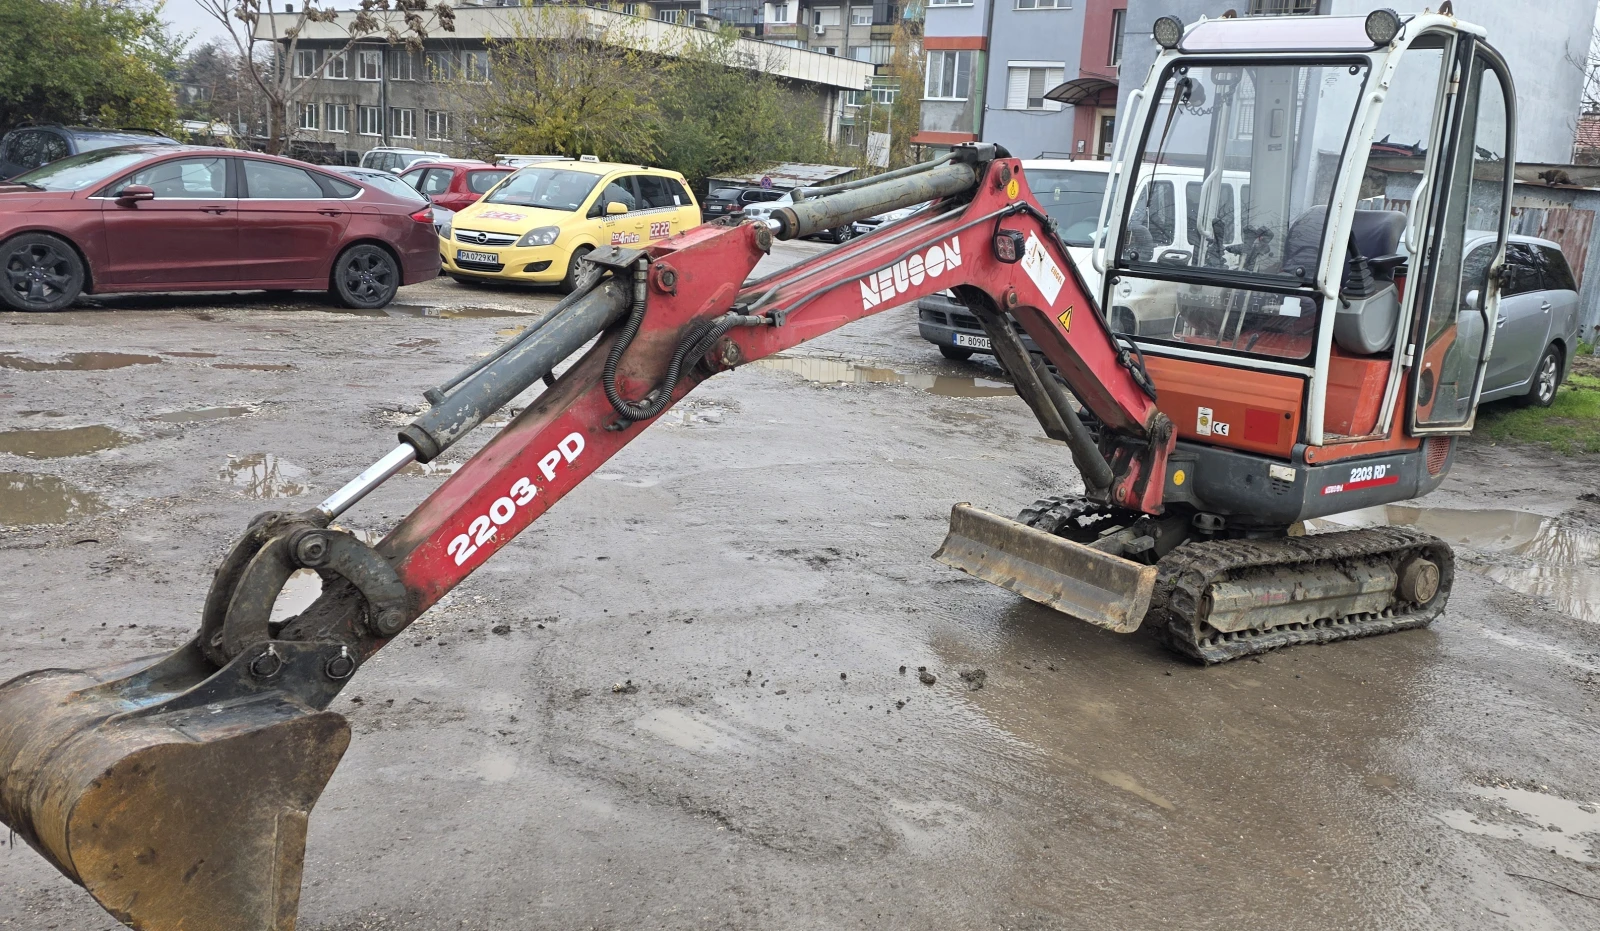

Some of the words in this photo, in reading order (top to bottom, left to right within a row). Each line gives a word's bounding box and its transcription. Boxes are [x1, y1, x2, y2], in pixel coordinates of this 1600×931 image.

[859, 235, 963, 311] NEUSON
[447, 476, 538, 567] 2203
[537, 431, 586, 482] PD
[1349, 465, 1373, 483] 2203
